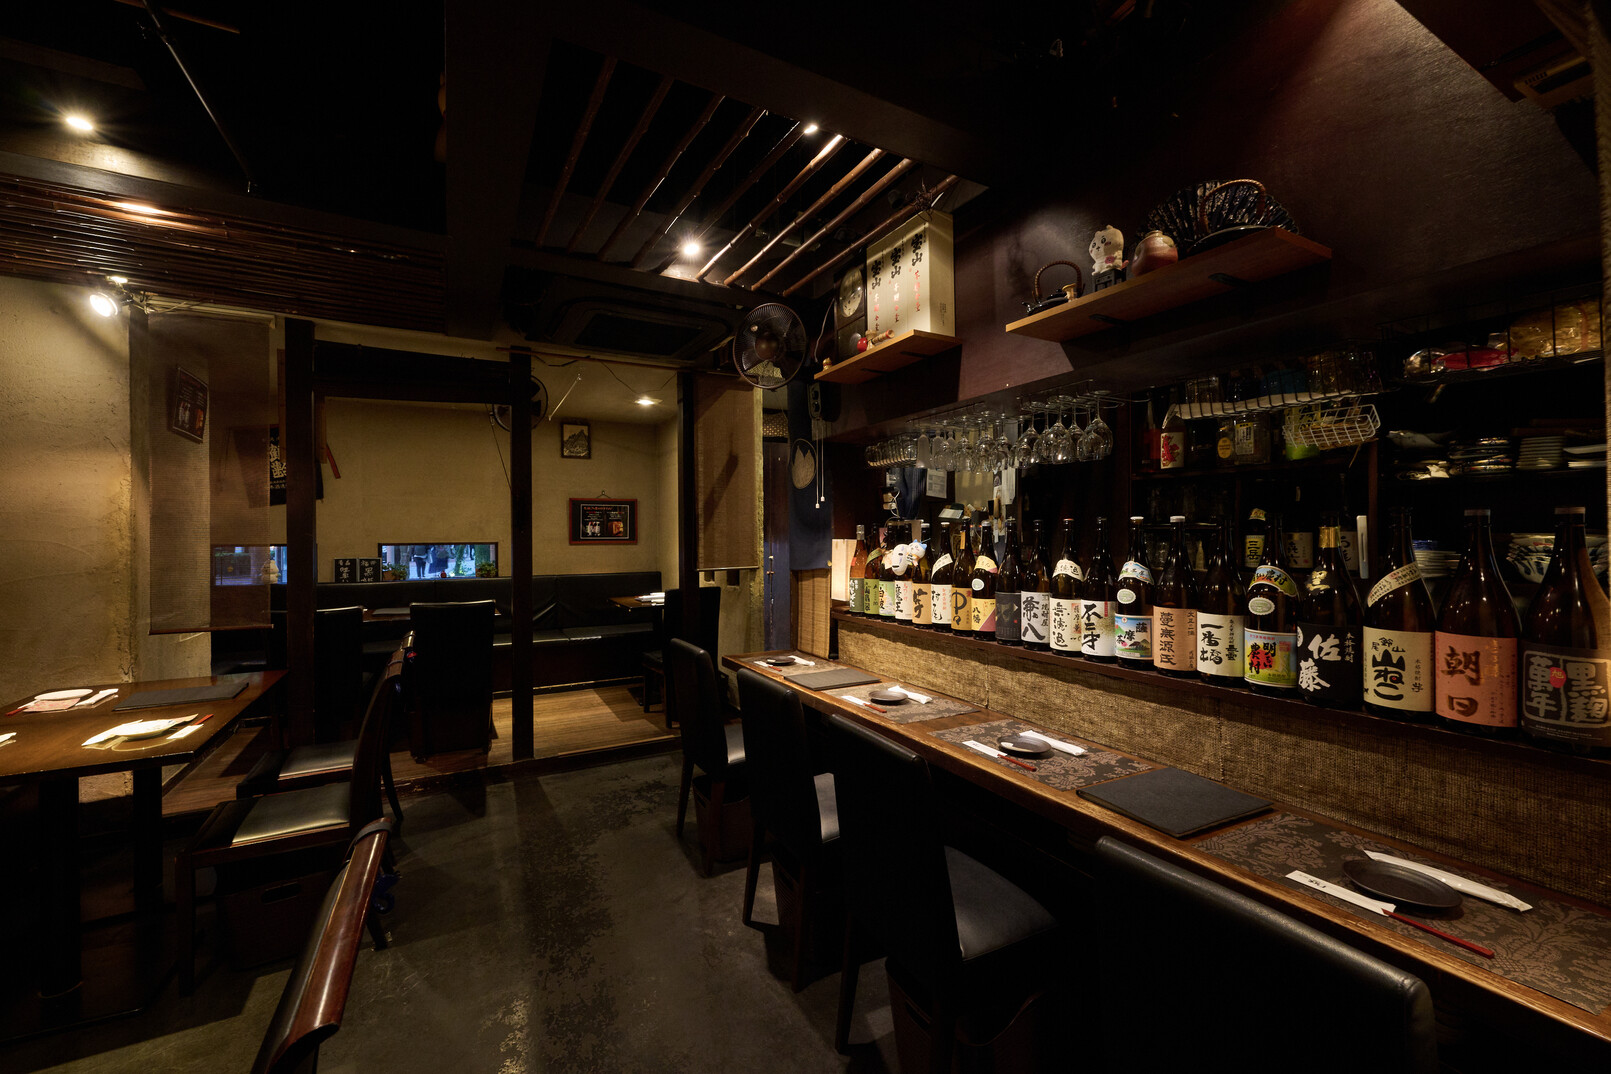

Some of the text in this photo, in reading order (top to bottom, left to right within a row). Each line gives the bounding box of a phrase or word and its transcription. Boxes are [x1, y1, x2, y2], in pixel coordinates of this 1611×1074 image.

[1305, 570, 1331, 591] 黒
[1022, 596, 1047, 641] 兼八
[1081, 603, 1103, 651] 不二才
[1297, 633, 1342, 693] 佐藤
[1372, 649, 1406, 701] 山ねこ
